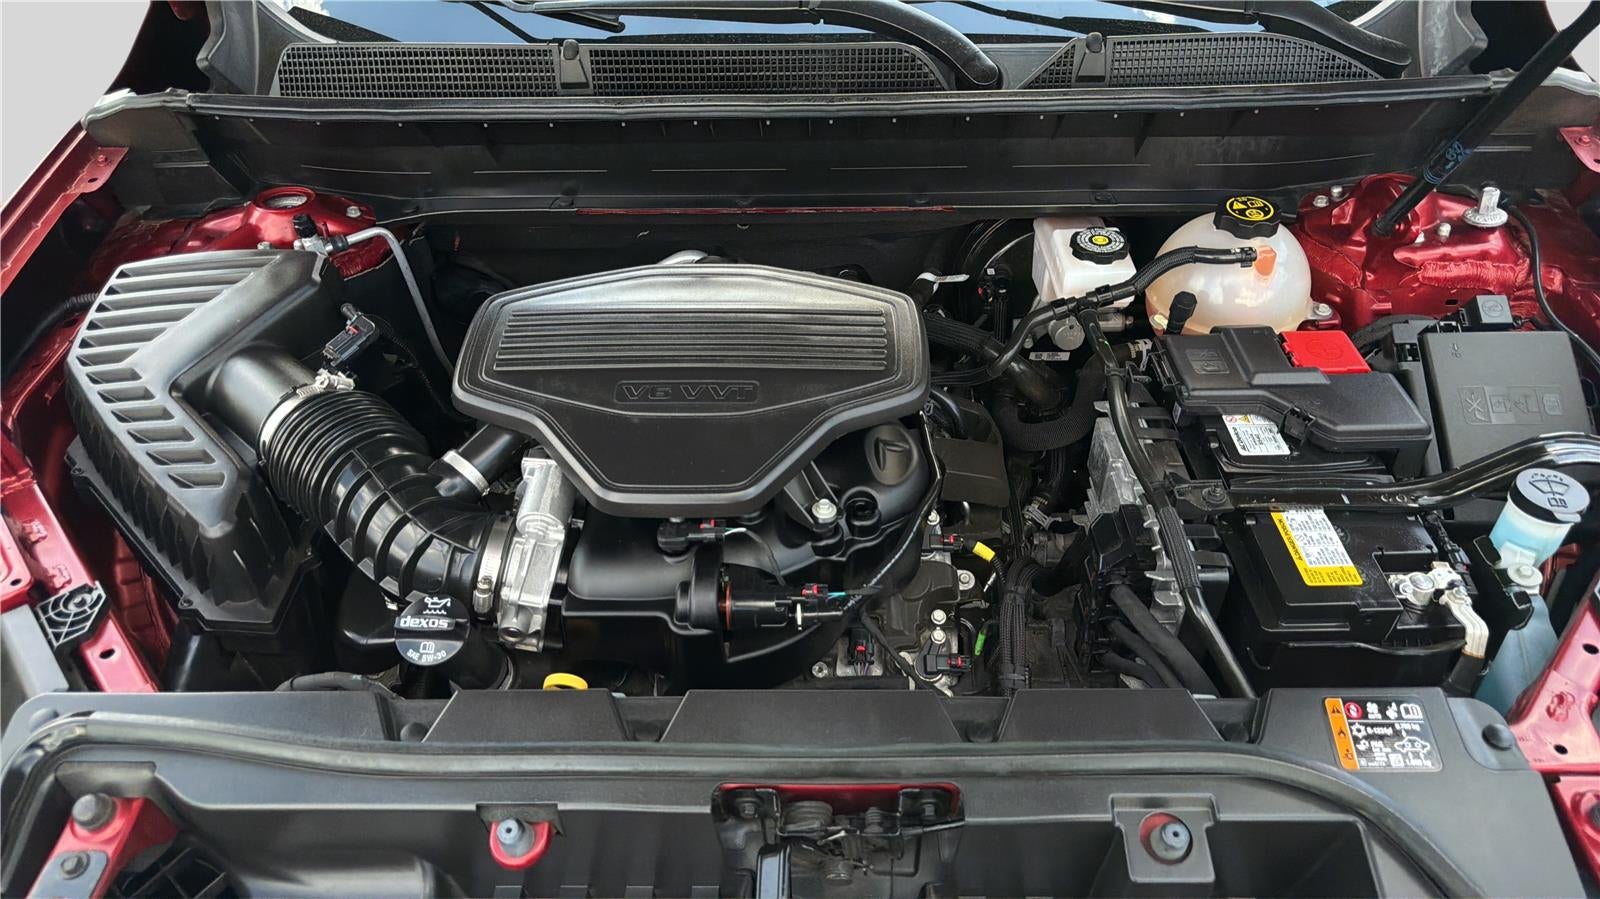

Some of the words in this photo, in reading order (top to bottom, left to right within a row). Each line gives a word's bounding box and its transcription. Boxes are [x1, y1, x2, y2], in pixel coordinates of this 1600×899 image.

[622, 384, 672, 400] V6
[680, 384, 753, 400] VVT
[400, 615, 449, 628] dexos
[406, 648, 420, 661] SAE
[421, 650, 447, 662] 5W-30
